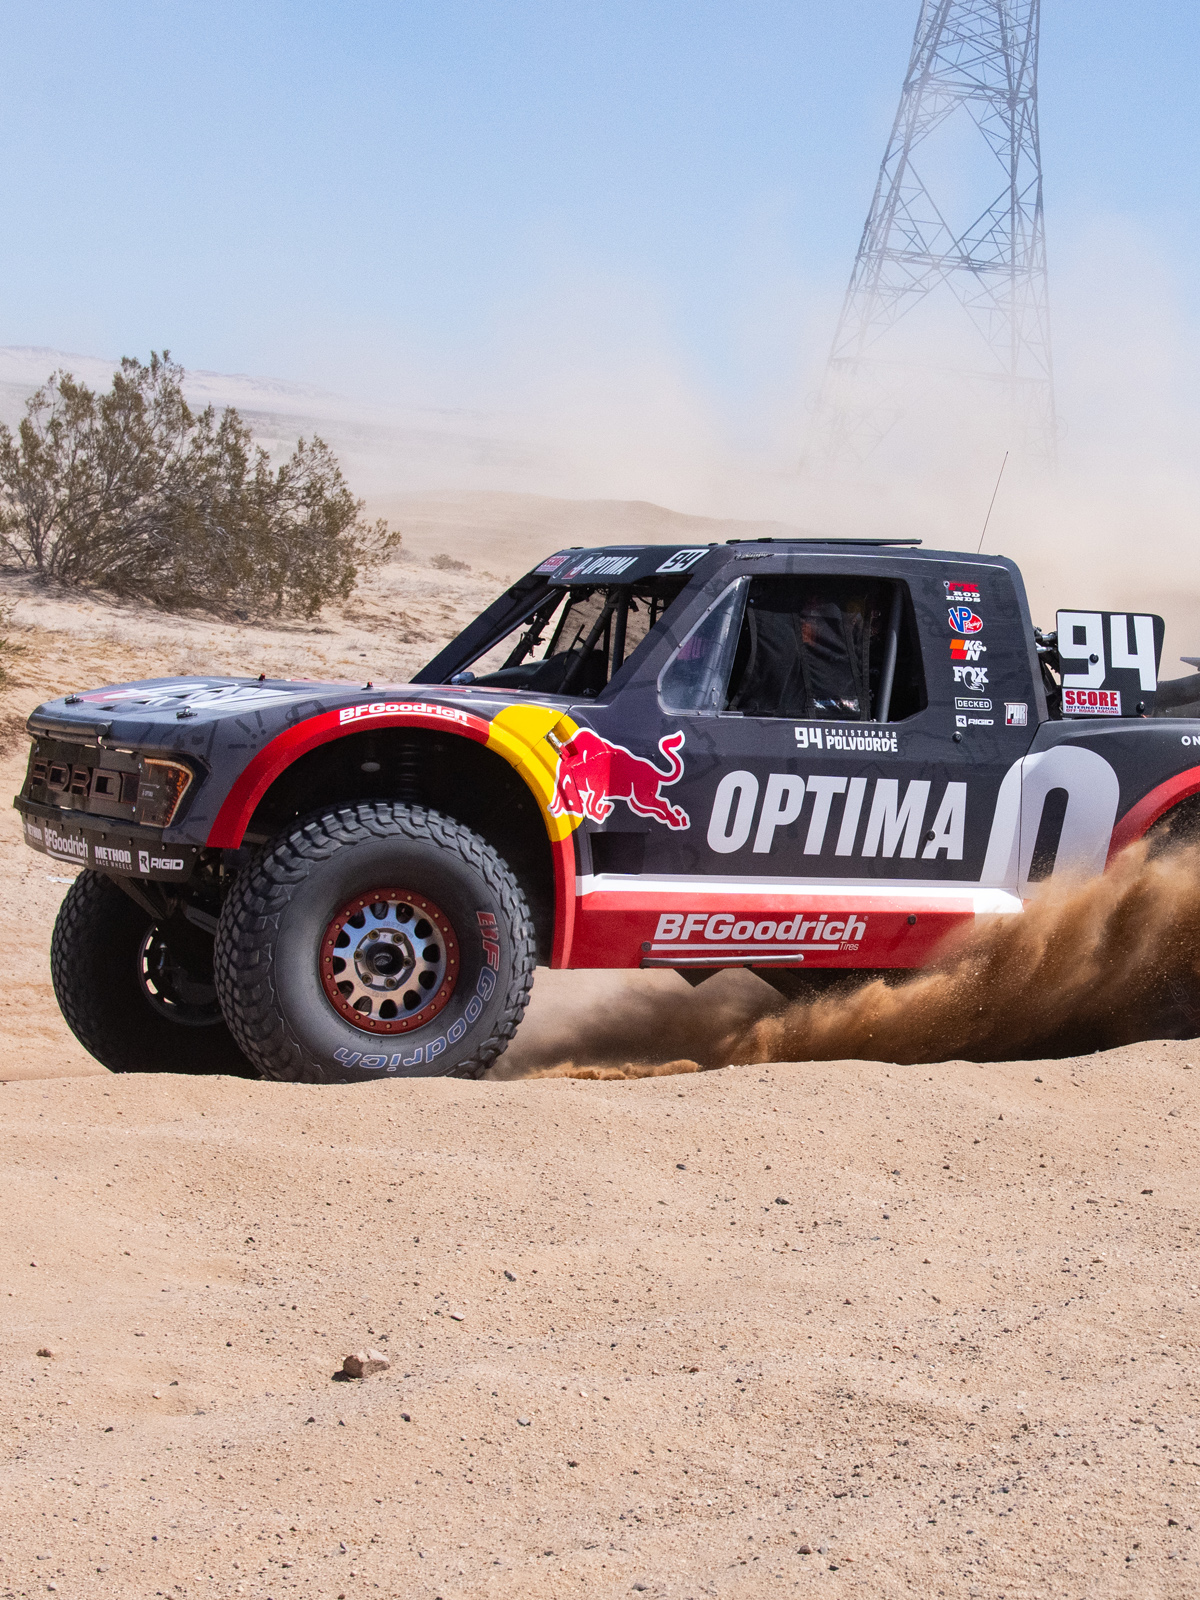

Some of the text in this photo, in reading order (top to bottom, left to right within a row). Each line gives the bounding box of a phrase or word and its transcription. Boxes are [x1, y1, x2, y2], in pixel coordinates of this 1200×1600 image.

[580, 556, 639, 576] OPTIMA
[948, 606, 972, 632] VP
[1057, 611, 1157, 691] 94
[953, 666, 989, 690] FOX
[958, 700, 990, 708] DECKED
[1065, 690, 1118, 707] SCORE
[340, 702, 468, 722] BFGoodrich
[968, 718, 994, 726] RIGID
[795, 727, 823, 749] 94
[825, 728, 897, 738] CHRISTOPHER
[826, 735, 899, 753] POLVOORDE
[706, 769, 968, 860] OPTIMA
[44, 826, 89, 858] BFGoodrich
[94, 845, 132, 864] METHOD
[150, 857, 184, 870] RIGID
[96, 859, 109, 867] RACE
[111, 861, 133, 871] WHEELS
[653, 913, 867, 941] BFGoodrich
[839, 941, 859, 951] Tires
[333, 909, 501, 1073] BFGoodrich
